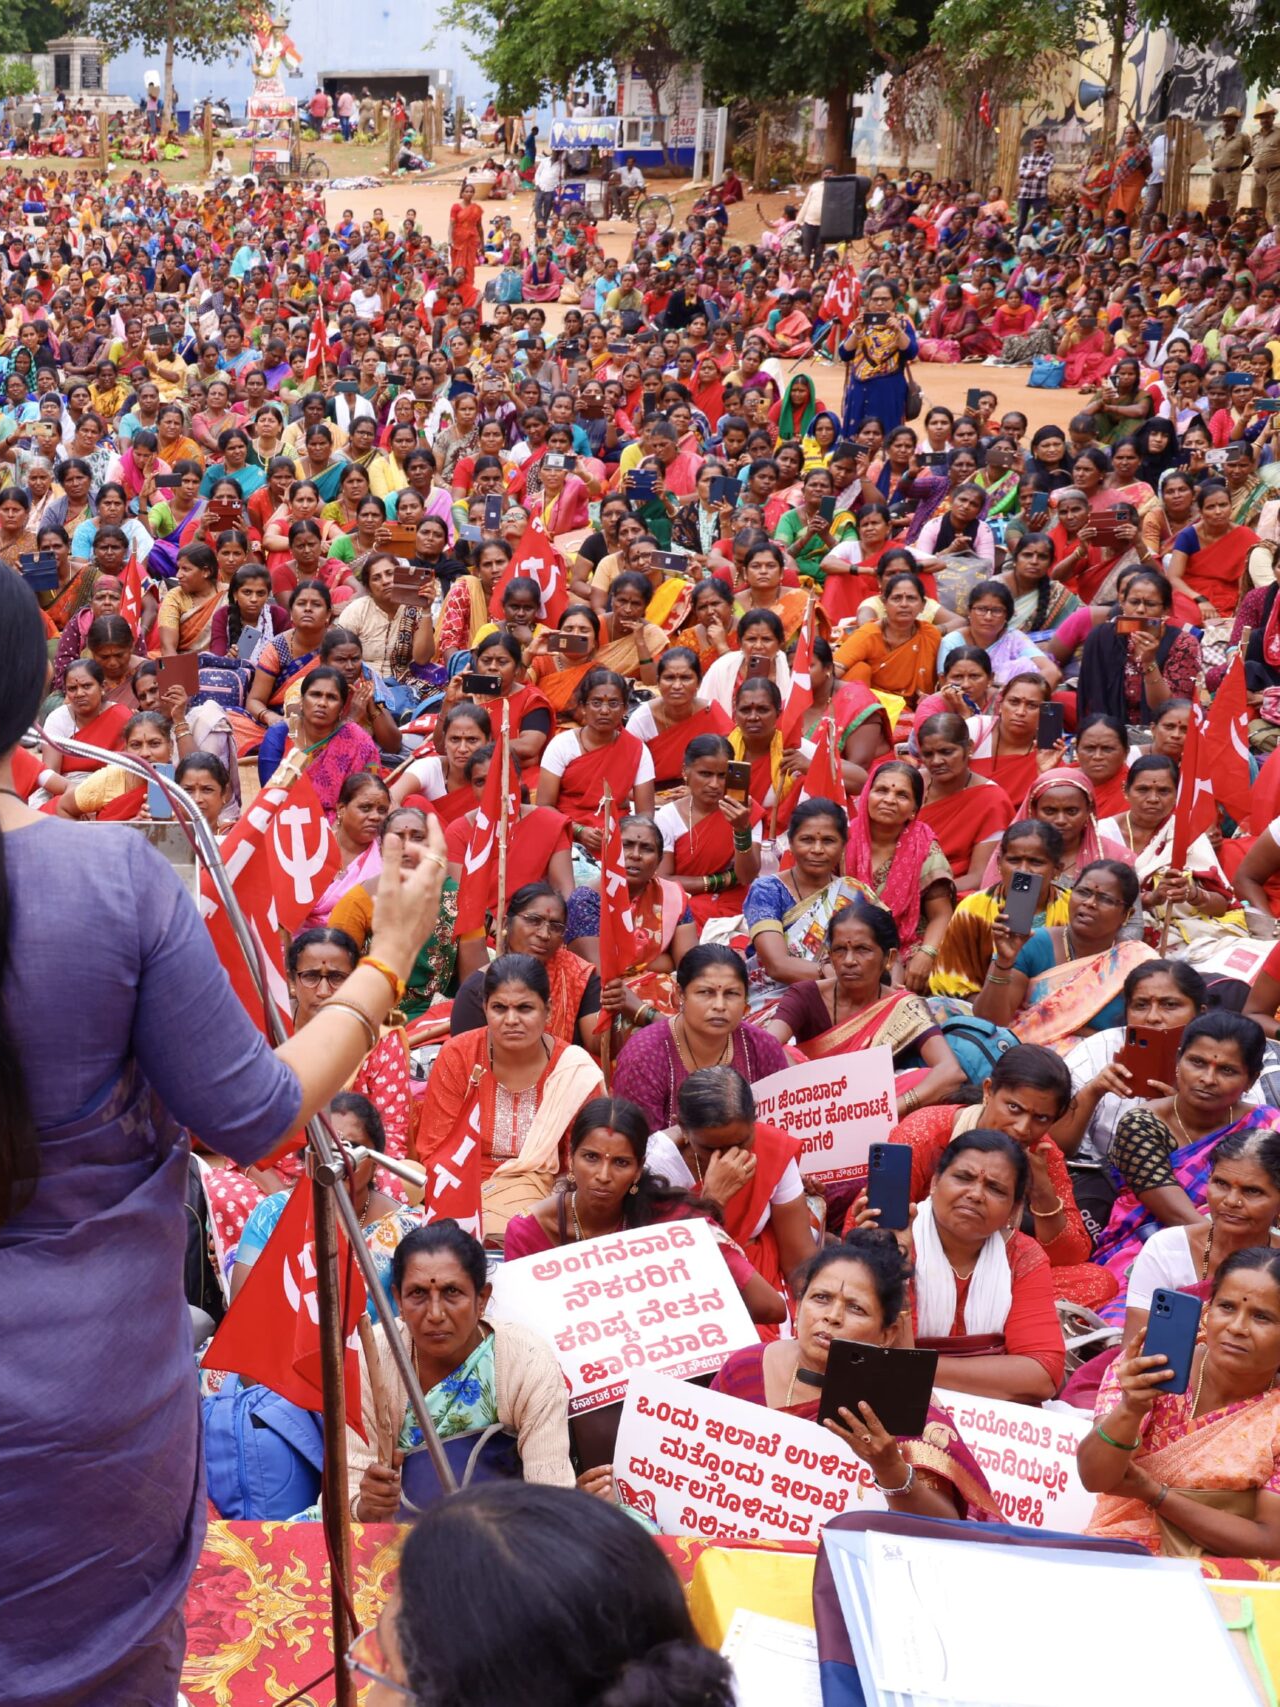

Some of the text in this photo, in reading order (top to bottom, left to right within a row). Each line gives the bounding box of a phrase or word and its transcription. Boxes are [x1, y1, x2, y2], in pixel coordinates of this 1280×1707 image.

[778, 1075, 847, 1110] ಜಿಂದಾಬಾದ್
[825, 1091, 893, 1125] ಹೋರಾಟಕ್ಕೆ
[531, 1226, 696, 1282] ಅಂಗನವಾಡಿ
[563, 1258, 692, 1312] ನೌಕರರಿಗೆ
[636, 1288, 726, 1328] ವೇತನ
[636, 1396, 699, 1432] ಒಂದು
[705, 1418, 782, 1457] ಇಲಾಖೆ
[960, 1408, 1052, 1449] ವಯೋಮಿತಿ
[628, 1456, 813, 1536] ದುರ್ಬಲಗೊಳಿಸುವ
[659, 1436, 849, 1514] ಮತ್ತೊಂದು ಇಲಾಖೆ
